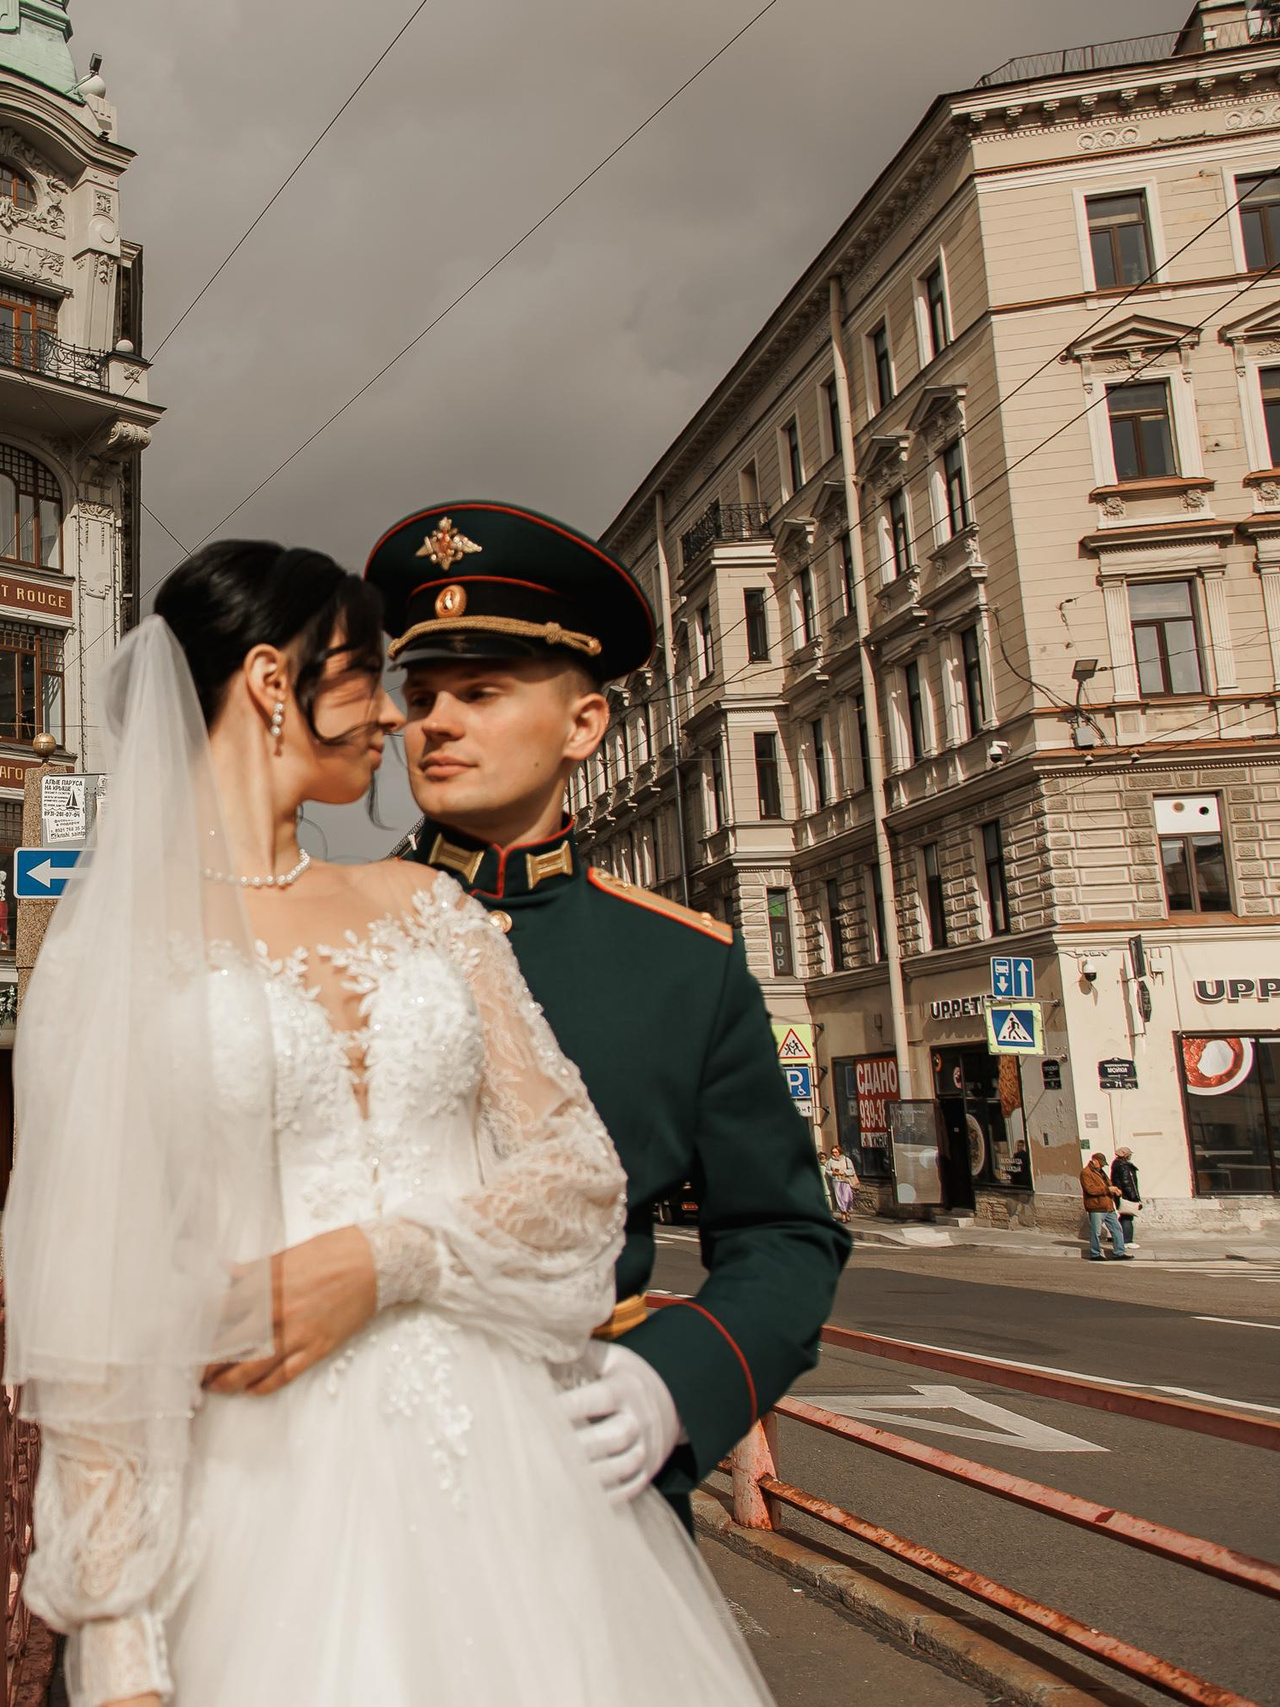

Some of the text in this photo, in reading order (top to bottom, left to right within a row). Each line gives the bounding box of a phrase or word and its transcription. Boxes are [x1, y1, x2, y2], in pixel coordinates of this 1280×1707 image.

[16, 587, 67, 609] ROUGE
[61, 779, 83, 787] ПАРУСА
[774, 931, 785, 970] ЛОР
[786, 1070, 804, 1094] P
[856, 1060, 898, 1096] СДАНО
